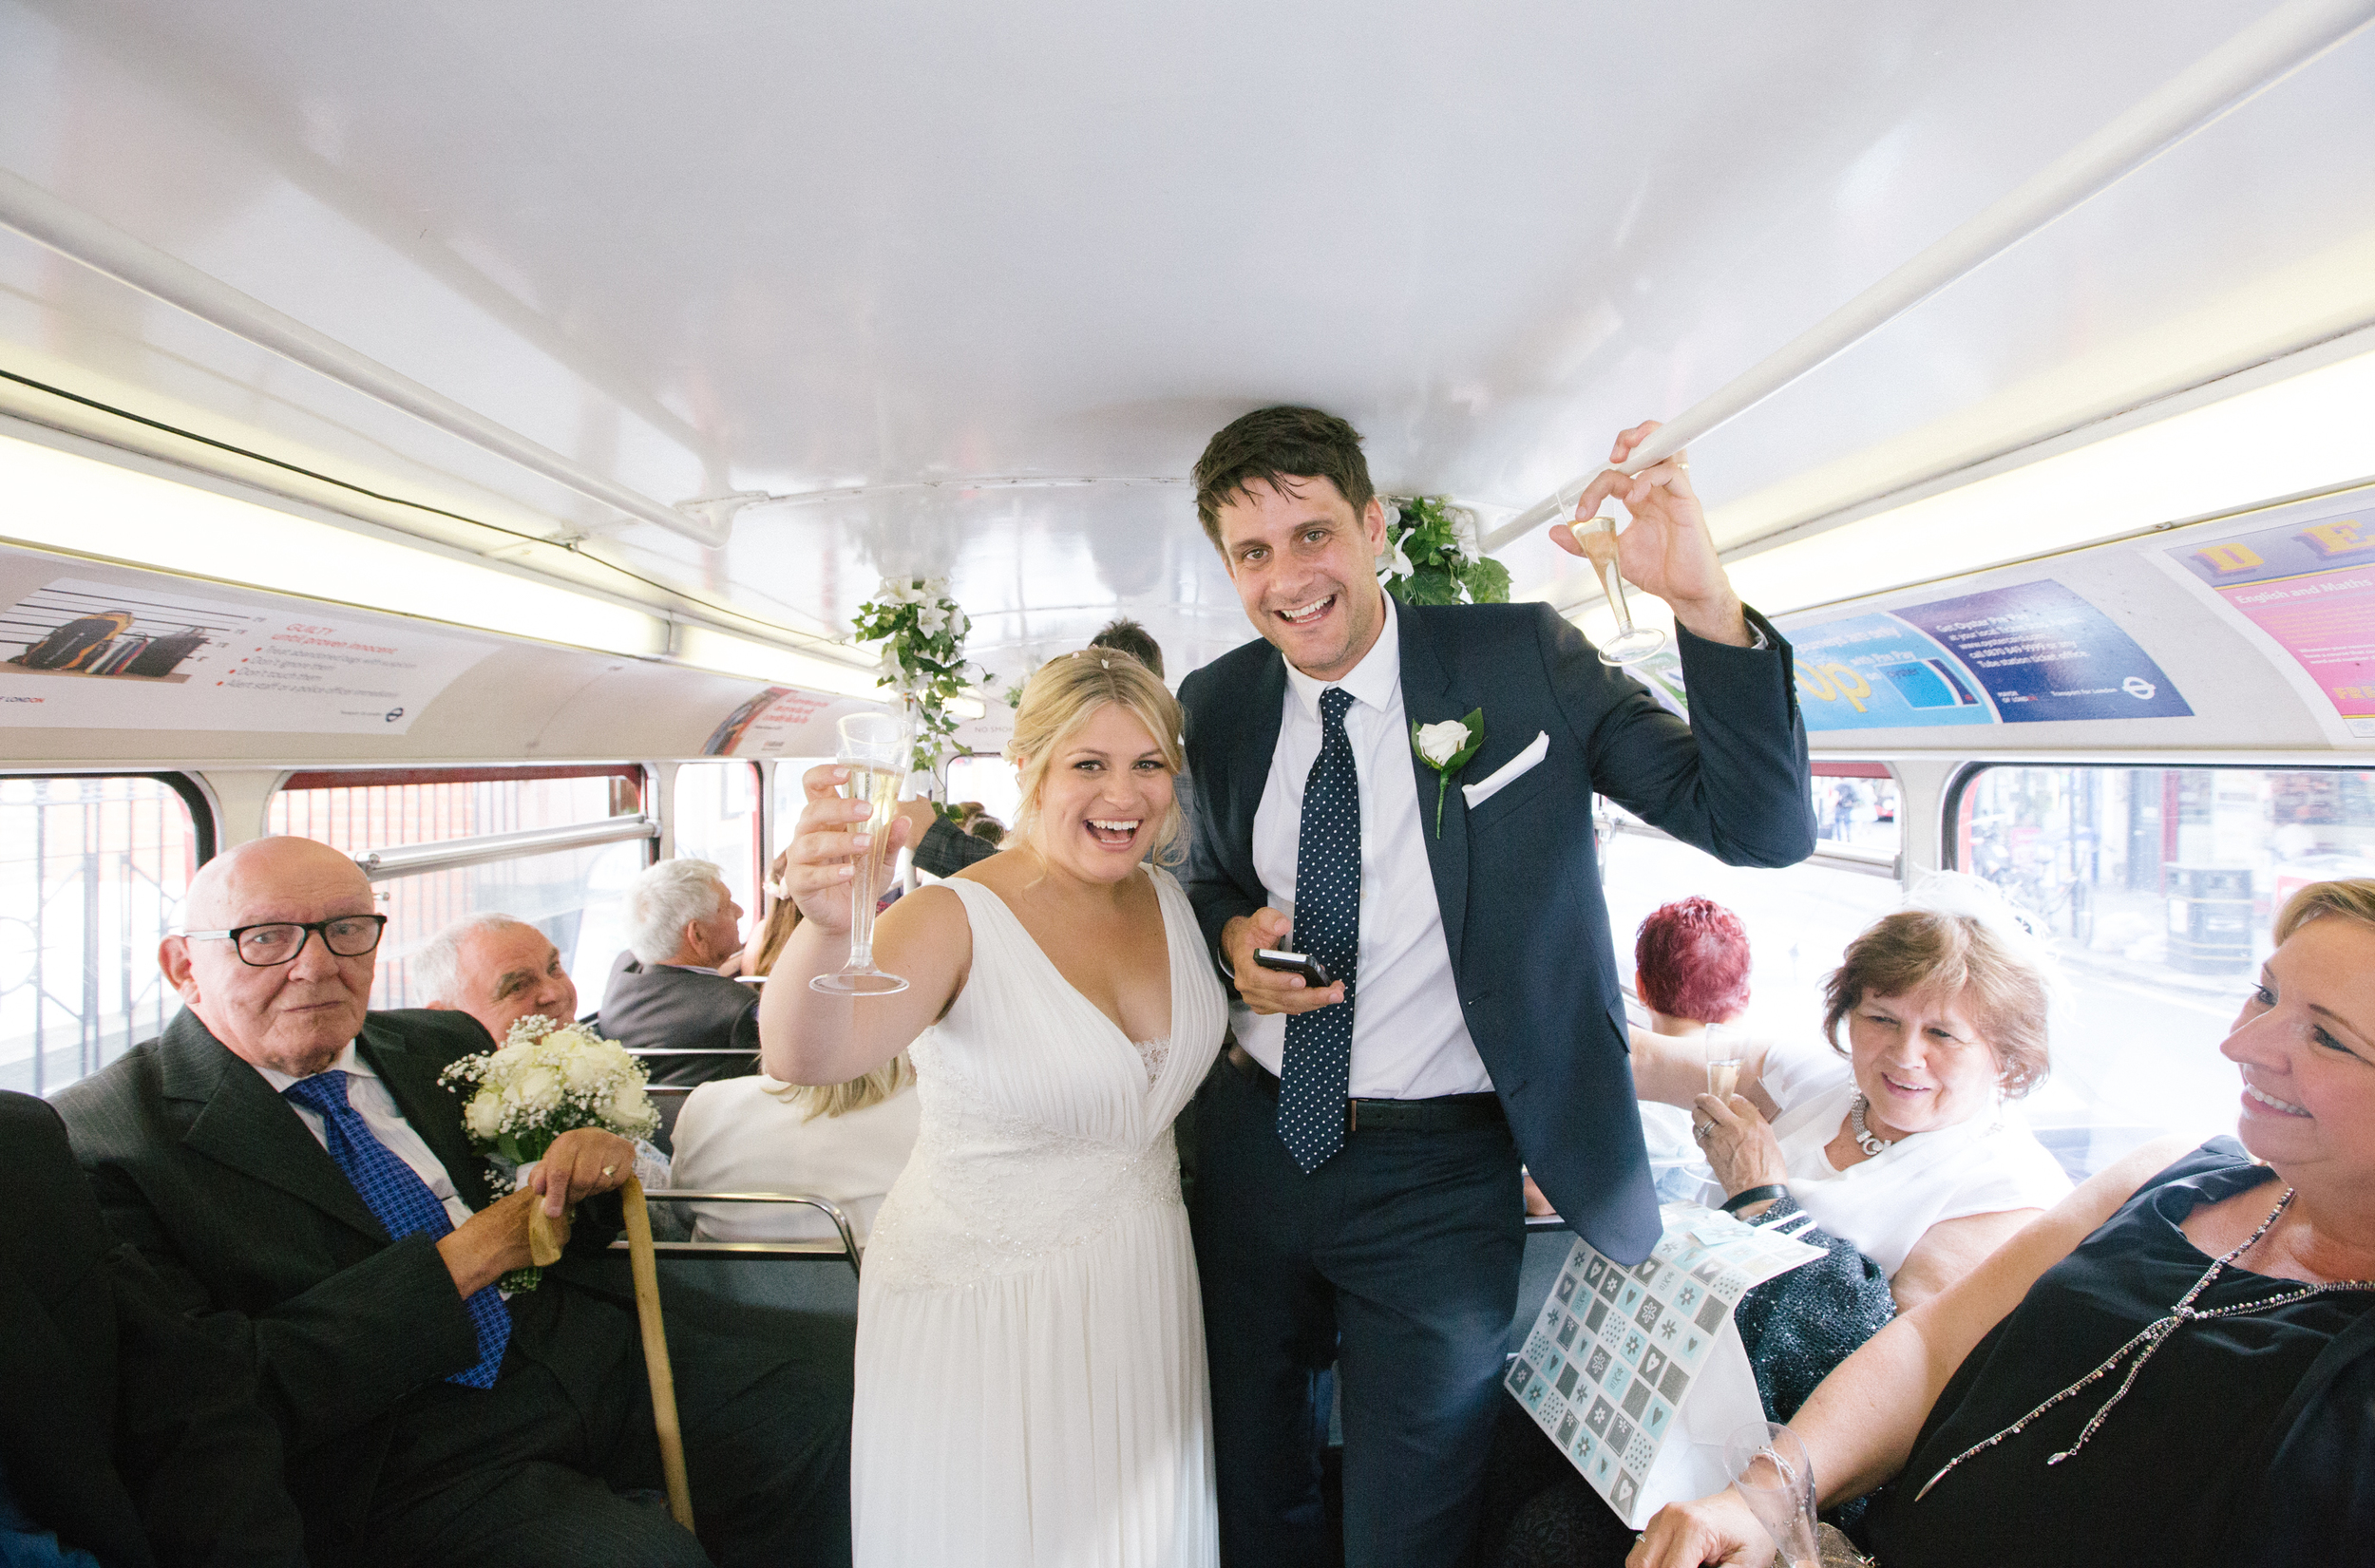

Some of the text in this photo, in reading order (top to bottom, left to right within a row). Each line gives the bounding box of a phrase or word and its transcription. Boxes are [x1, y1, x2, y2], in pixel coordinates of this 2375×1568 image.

[2235, 578, 2374, 604] English and Maths
[1954, 620, 1990, 632] Oyster
[1969, 650, 1986, 659] call
[1976, 660, 2002, 669] Tube
[1793, 658, 1872, 712] 0p
[2333, 686, 2375, 700] FRE
